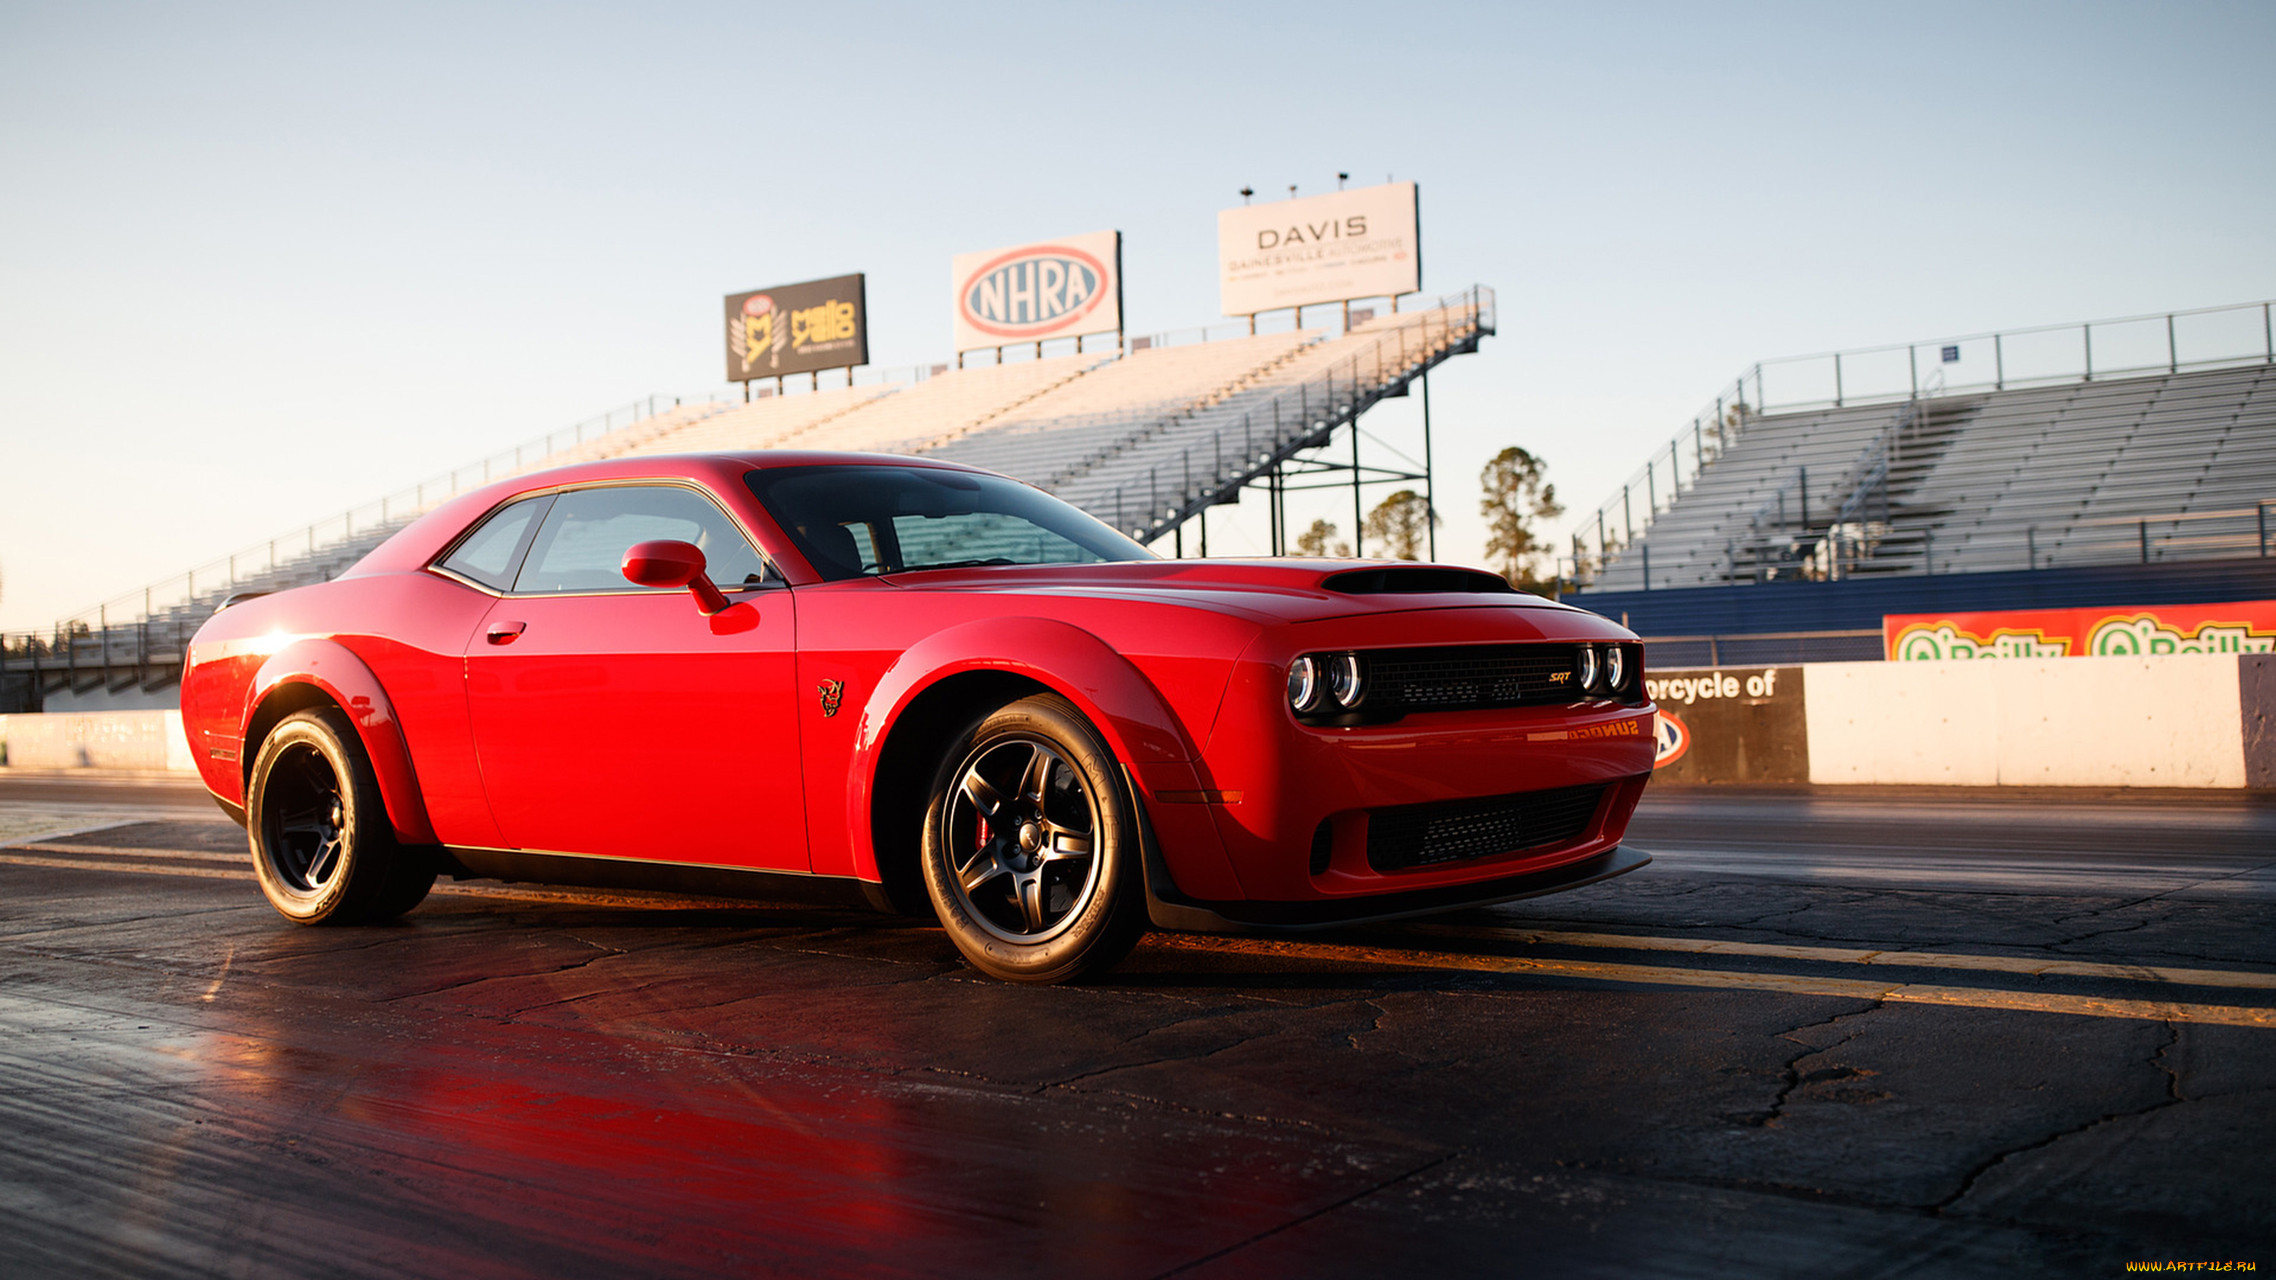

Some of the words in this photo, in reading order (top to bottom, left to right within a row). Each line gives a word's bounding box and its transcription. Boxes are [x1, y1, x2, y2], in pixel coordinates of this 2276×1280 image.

[1258, 215, 1367, 250] DAVIS
[979, 259, 1089, 323] NHRA
[1549, 671, 1571, 684] SRT
[1746, 669, 1776, 697] of
